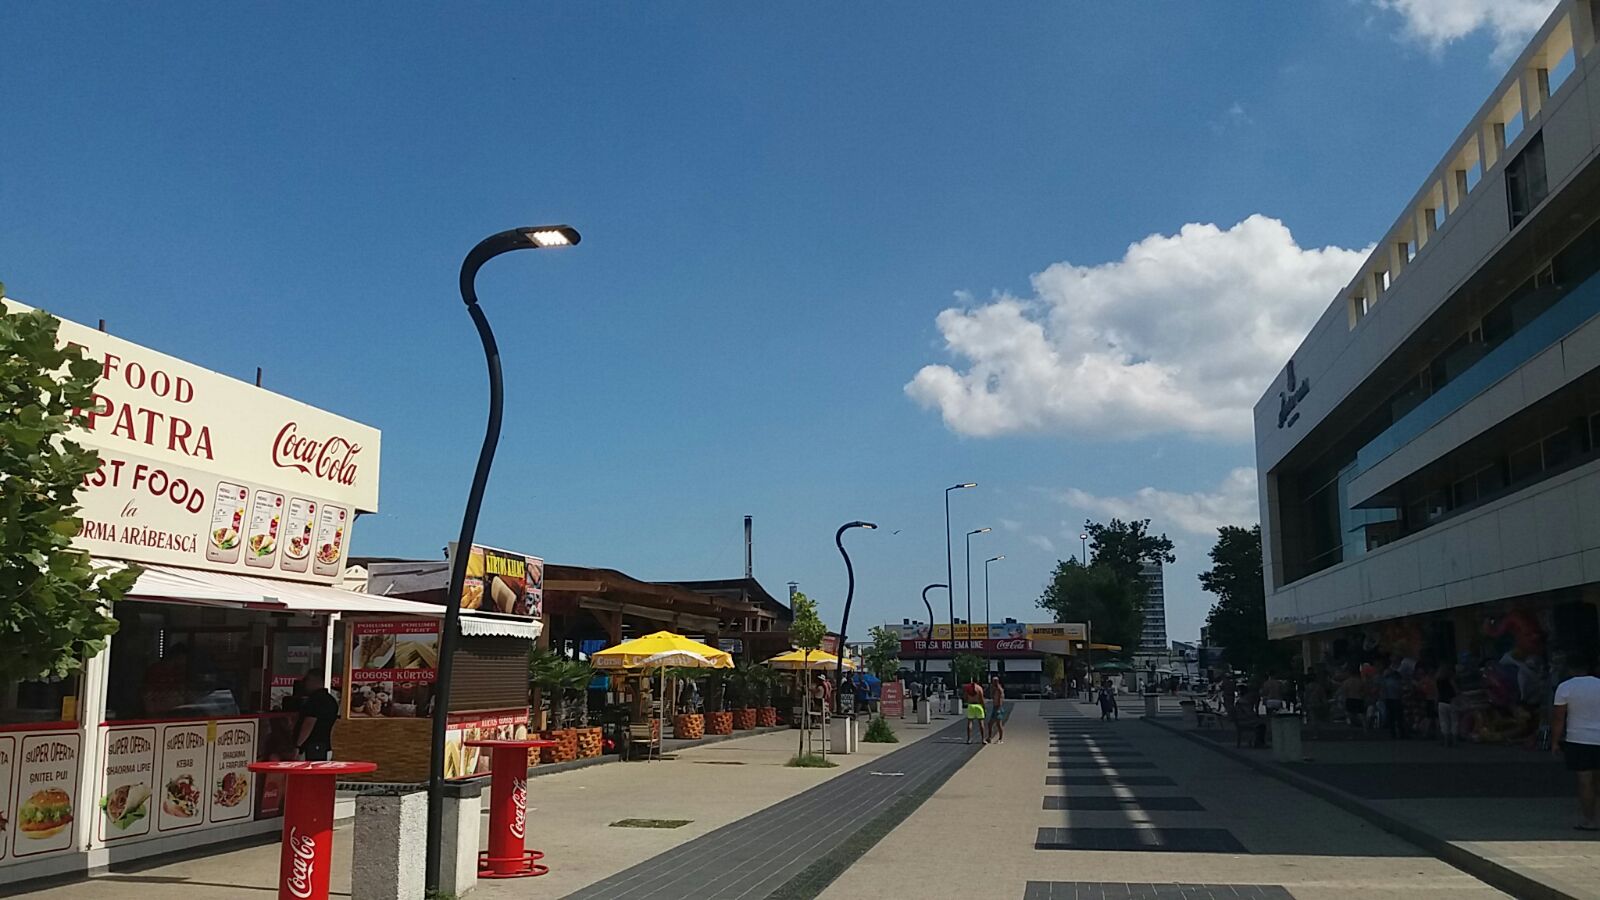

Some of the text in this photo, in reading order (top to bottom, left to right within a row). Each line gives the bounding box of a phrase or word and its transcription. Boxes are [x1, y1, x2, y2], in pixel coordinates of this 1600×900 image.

[103, 352, 194, 404] FOOD
[271, 421, 362, 486] Coca-Cola
[132, 464, 205, 514] FOOD
[120, 498, 138, 518] la
[77, 520, 198, 553] RMA ARĂBEASCĂ
[108, 736, 130, 755] SUPER
[166, 732, 186, 750] SUPER
[217, 729, 234, 746] SUPER
[25, 742, 49, 763] SUPER
[50, 742, 75, 762] OFERTA
[106, 763, 152, 776] SHAORMA LIPIE
[176, 759, 194, 768] KEBAB
[56, 770, 68, 780] PUI
